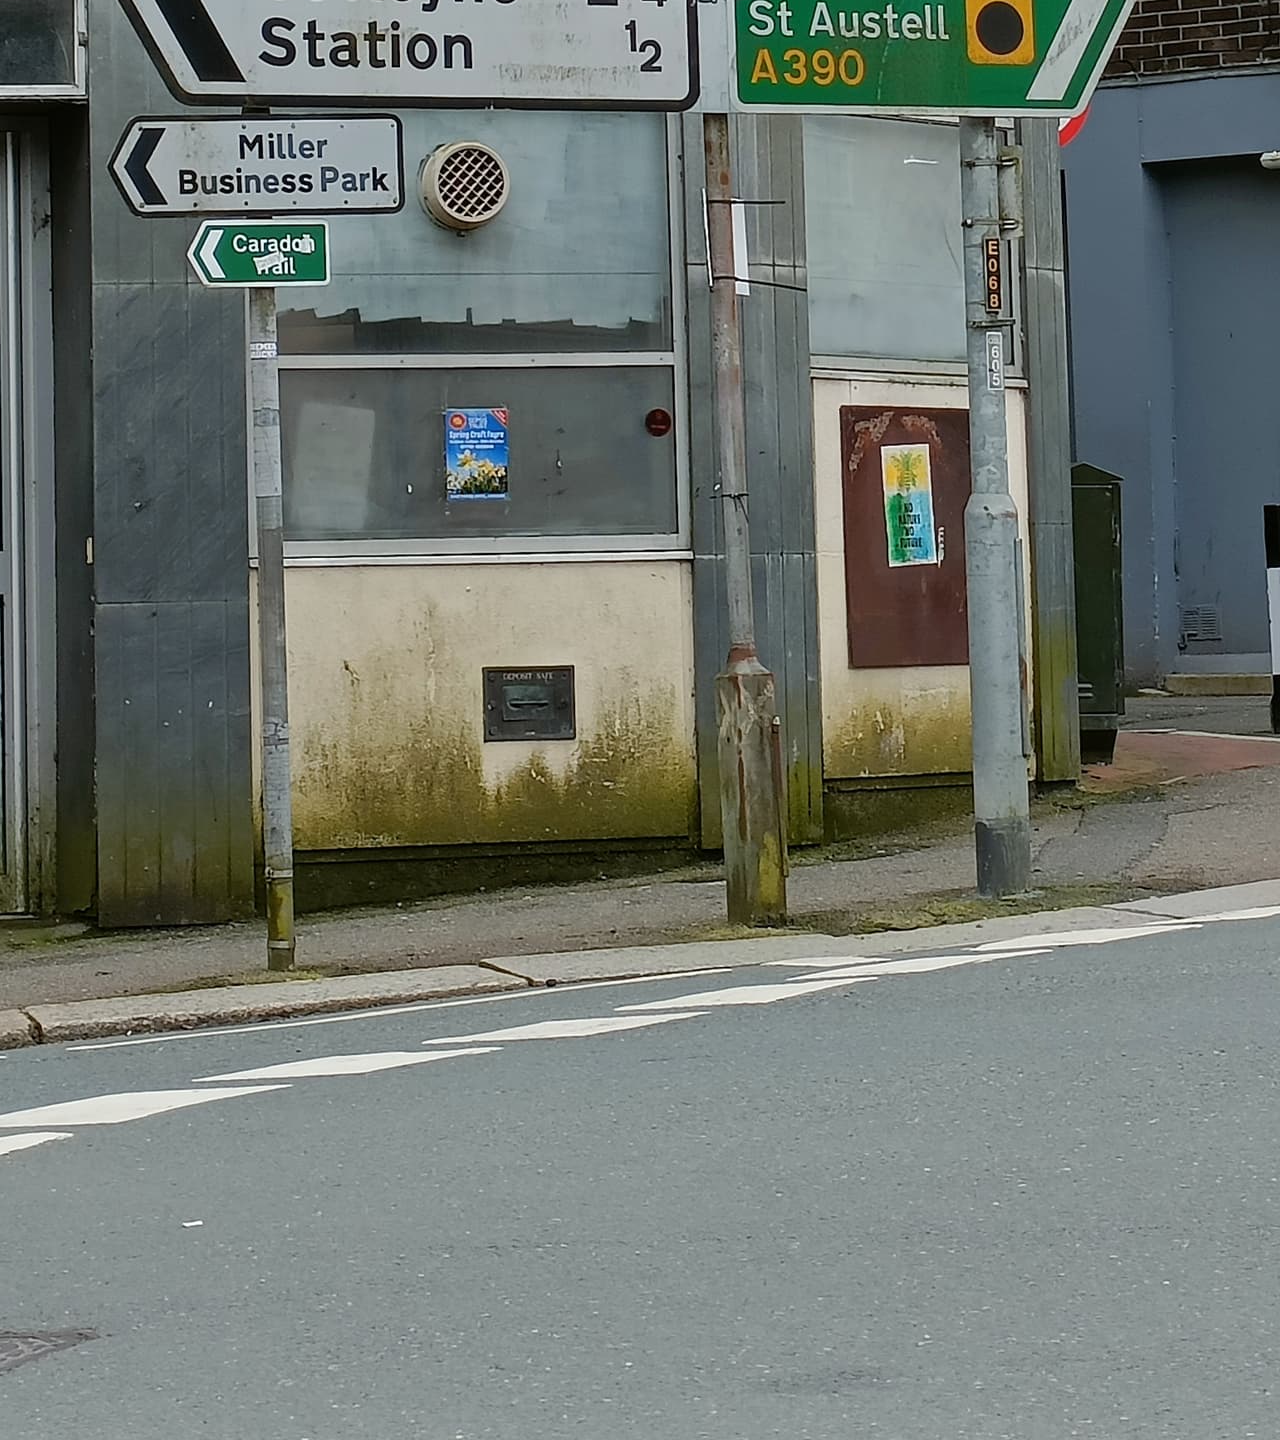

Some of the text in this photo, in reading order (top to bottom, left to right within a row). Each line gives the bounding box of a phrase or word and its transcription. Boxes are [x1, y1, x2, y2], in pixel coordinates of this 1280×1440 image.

[748, 0, 949, 40] St Austell
[260, 17, 473, 70] Station
[750, 48, 865, 86] A390
[238, 134, 328, 161] Miller
[178, 168, 389, 196] Business Park
